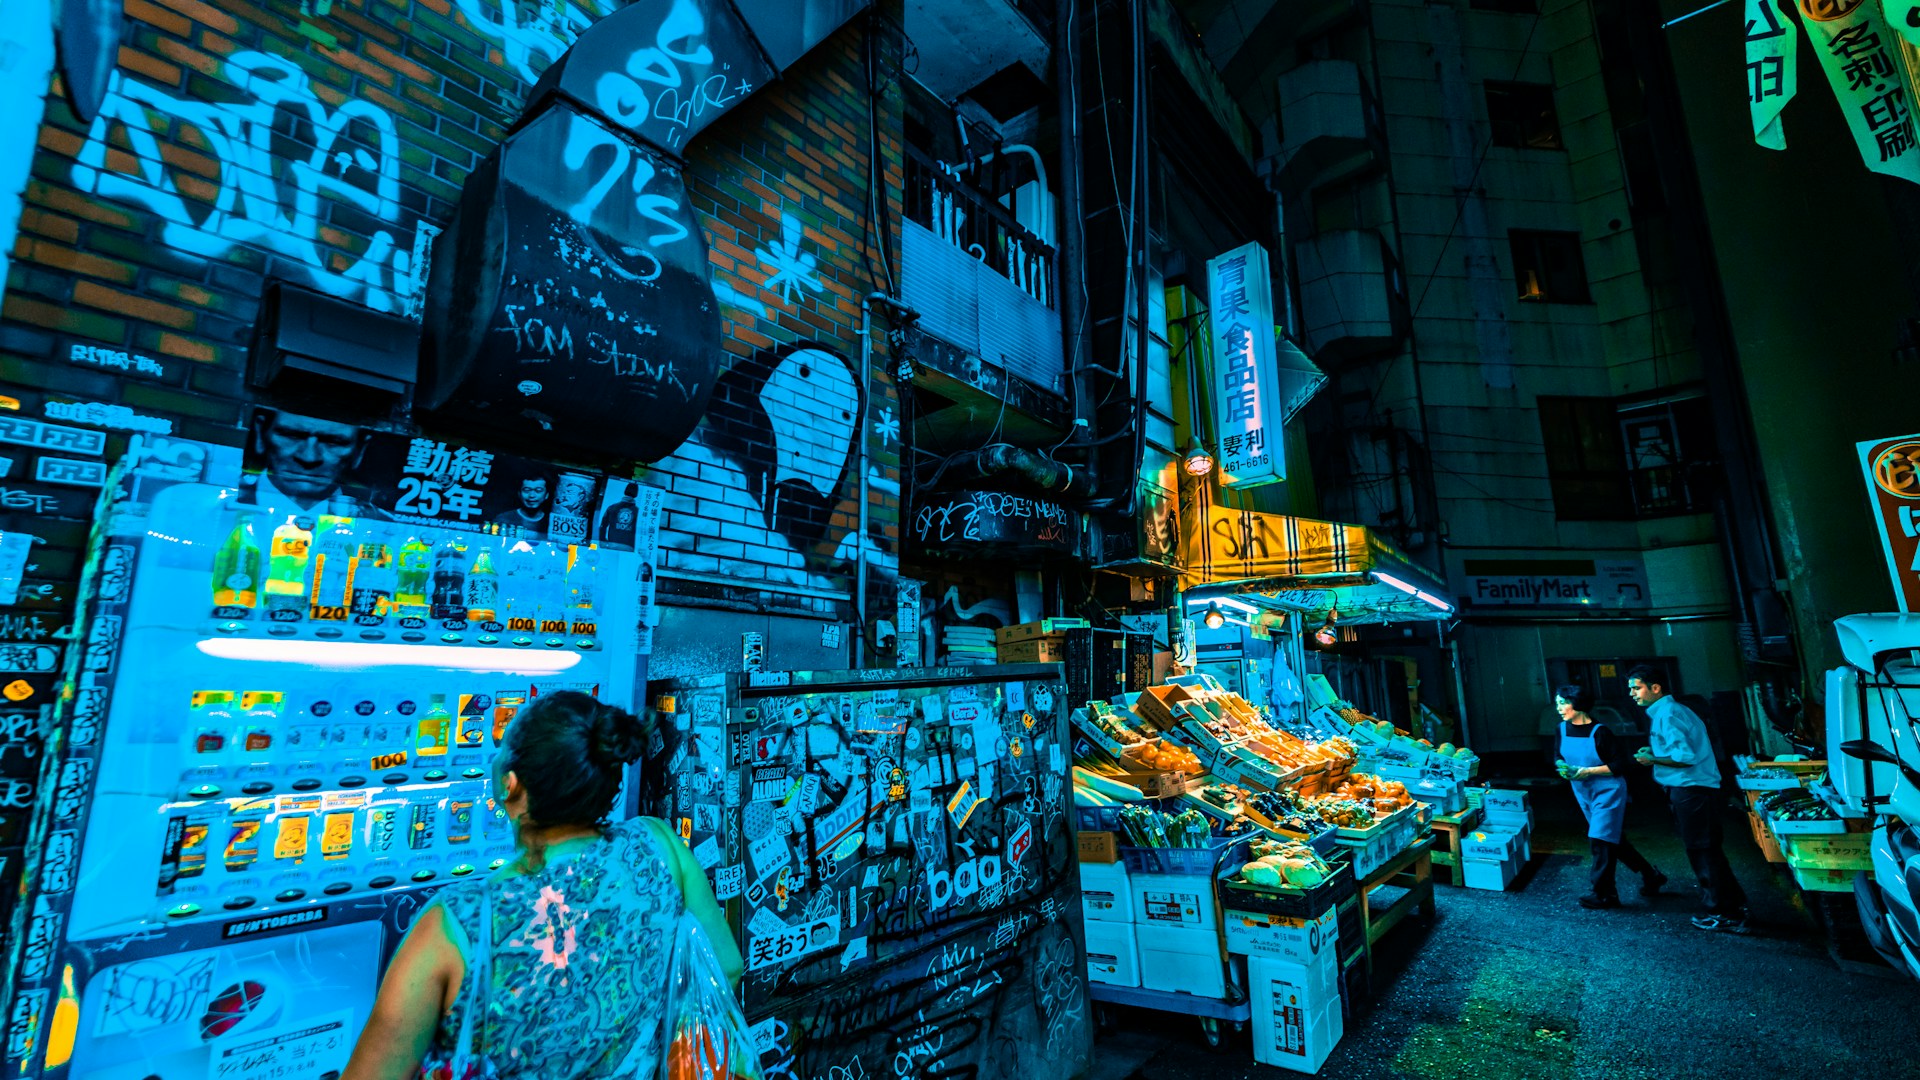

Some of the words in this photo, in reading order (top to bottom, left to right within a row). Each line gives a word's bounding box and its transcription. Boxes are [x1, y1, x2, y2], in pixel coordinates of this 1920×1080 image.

[1217, 254, 1256, 424] 青果食品店
[1223, 427, 1265, 458] 妻利
[403, 438, 494, 485] 勤続
[1224, 454, 1269, 473] 461-6616
[394, 477, 483, 520] 25年
[552, 521, 586, 535] BOSS
[1475, 578, 1591, 604] FamilyMart
[750, 633, 762, 673] BLACK
[742, 733, 751, 762] OVER
[754, 767, 787, 781] BRAIN
[752, 780, 786, 800] ALONE
[889, 784, 905, 797] 46
[381, 810, 395, 851] BOSS
[752, 926, 808, 966] 笑おう
